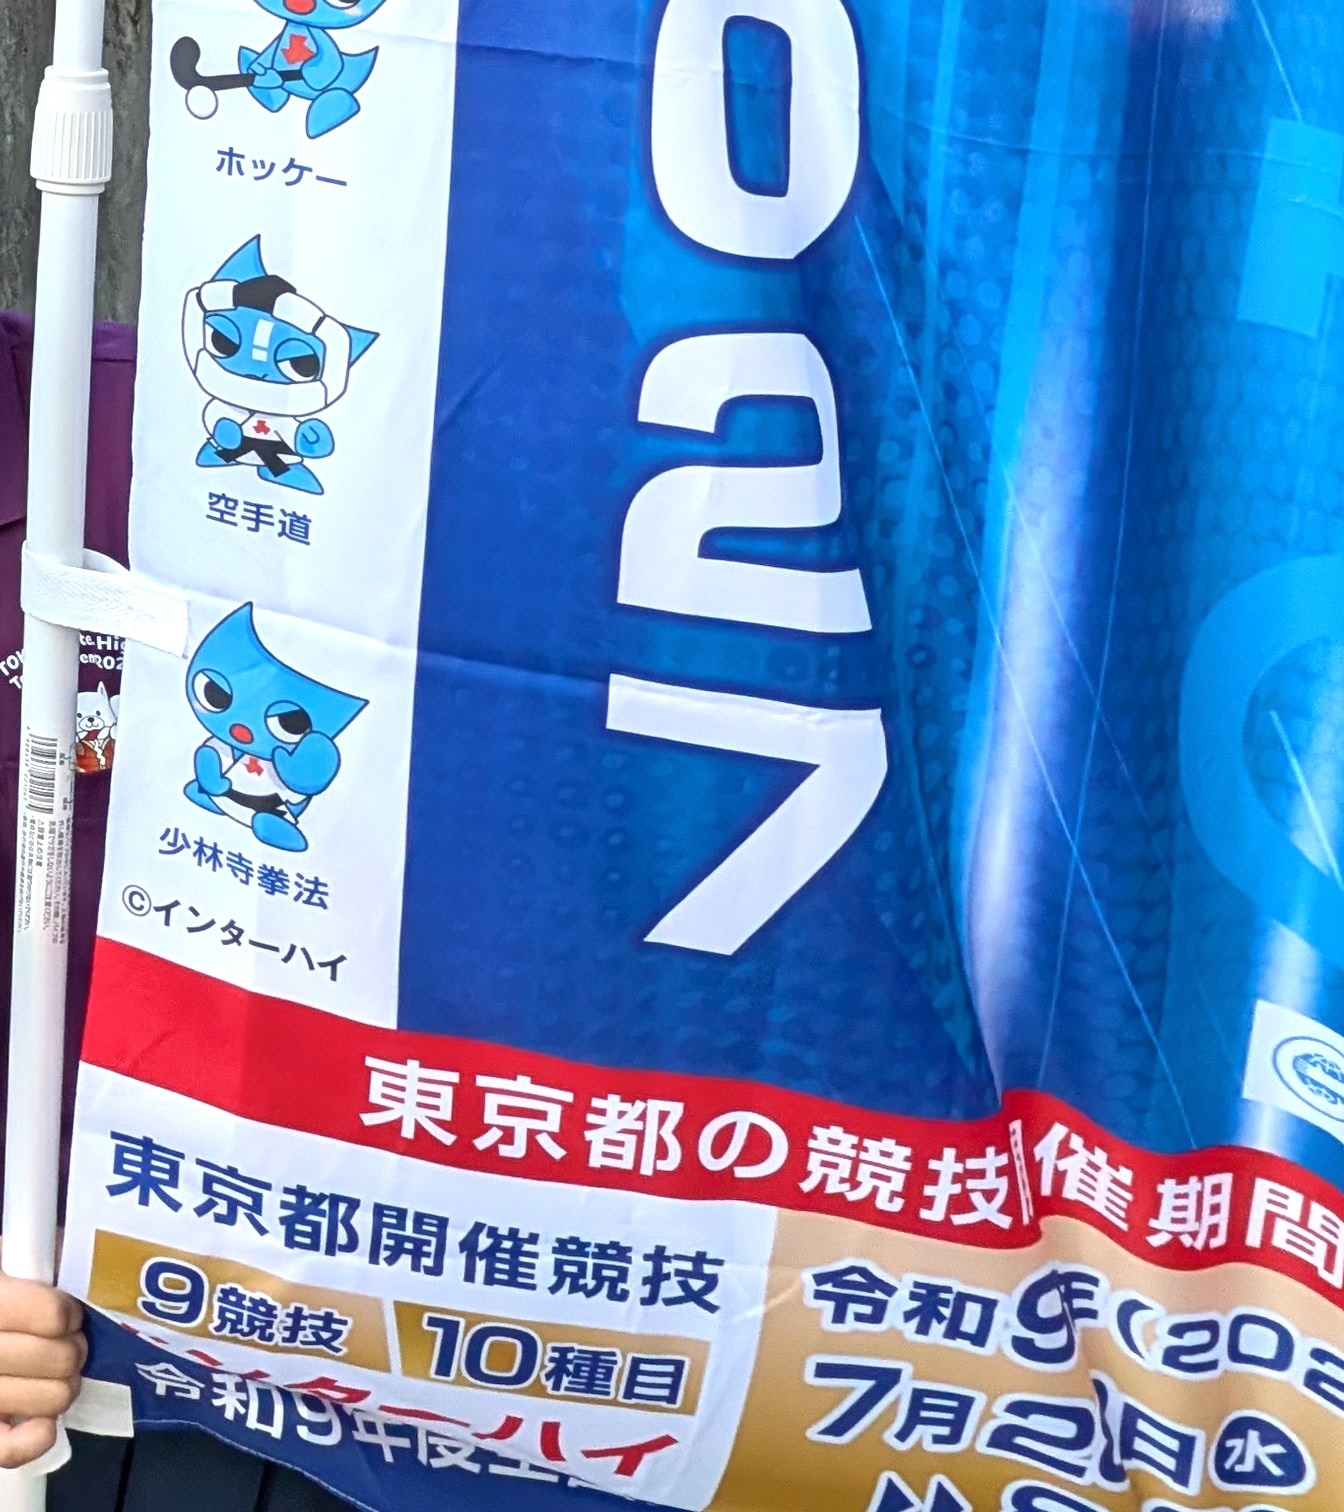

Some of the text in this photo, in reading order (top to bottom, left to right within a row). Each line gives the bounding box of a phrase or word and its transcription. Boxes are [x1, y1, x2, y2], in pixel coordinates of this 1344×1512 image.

[216, 146, 348, 188] ホッケー
[205, 491, 312, 547] 空手道
[158, 826, 330, 911] 少林寺拳法
[121, 884, 349, 983] ©インターハイ
[359, 1052, 1344, 1291] 東京都の競技催期間
[105, 1130, 726, 1315] 東京都開催競技
[139, 1259, 350, 1356] 9競技
[421, 1314, 688, 1408] 10種目
